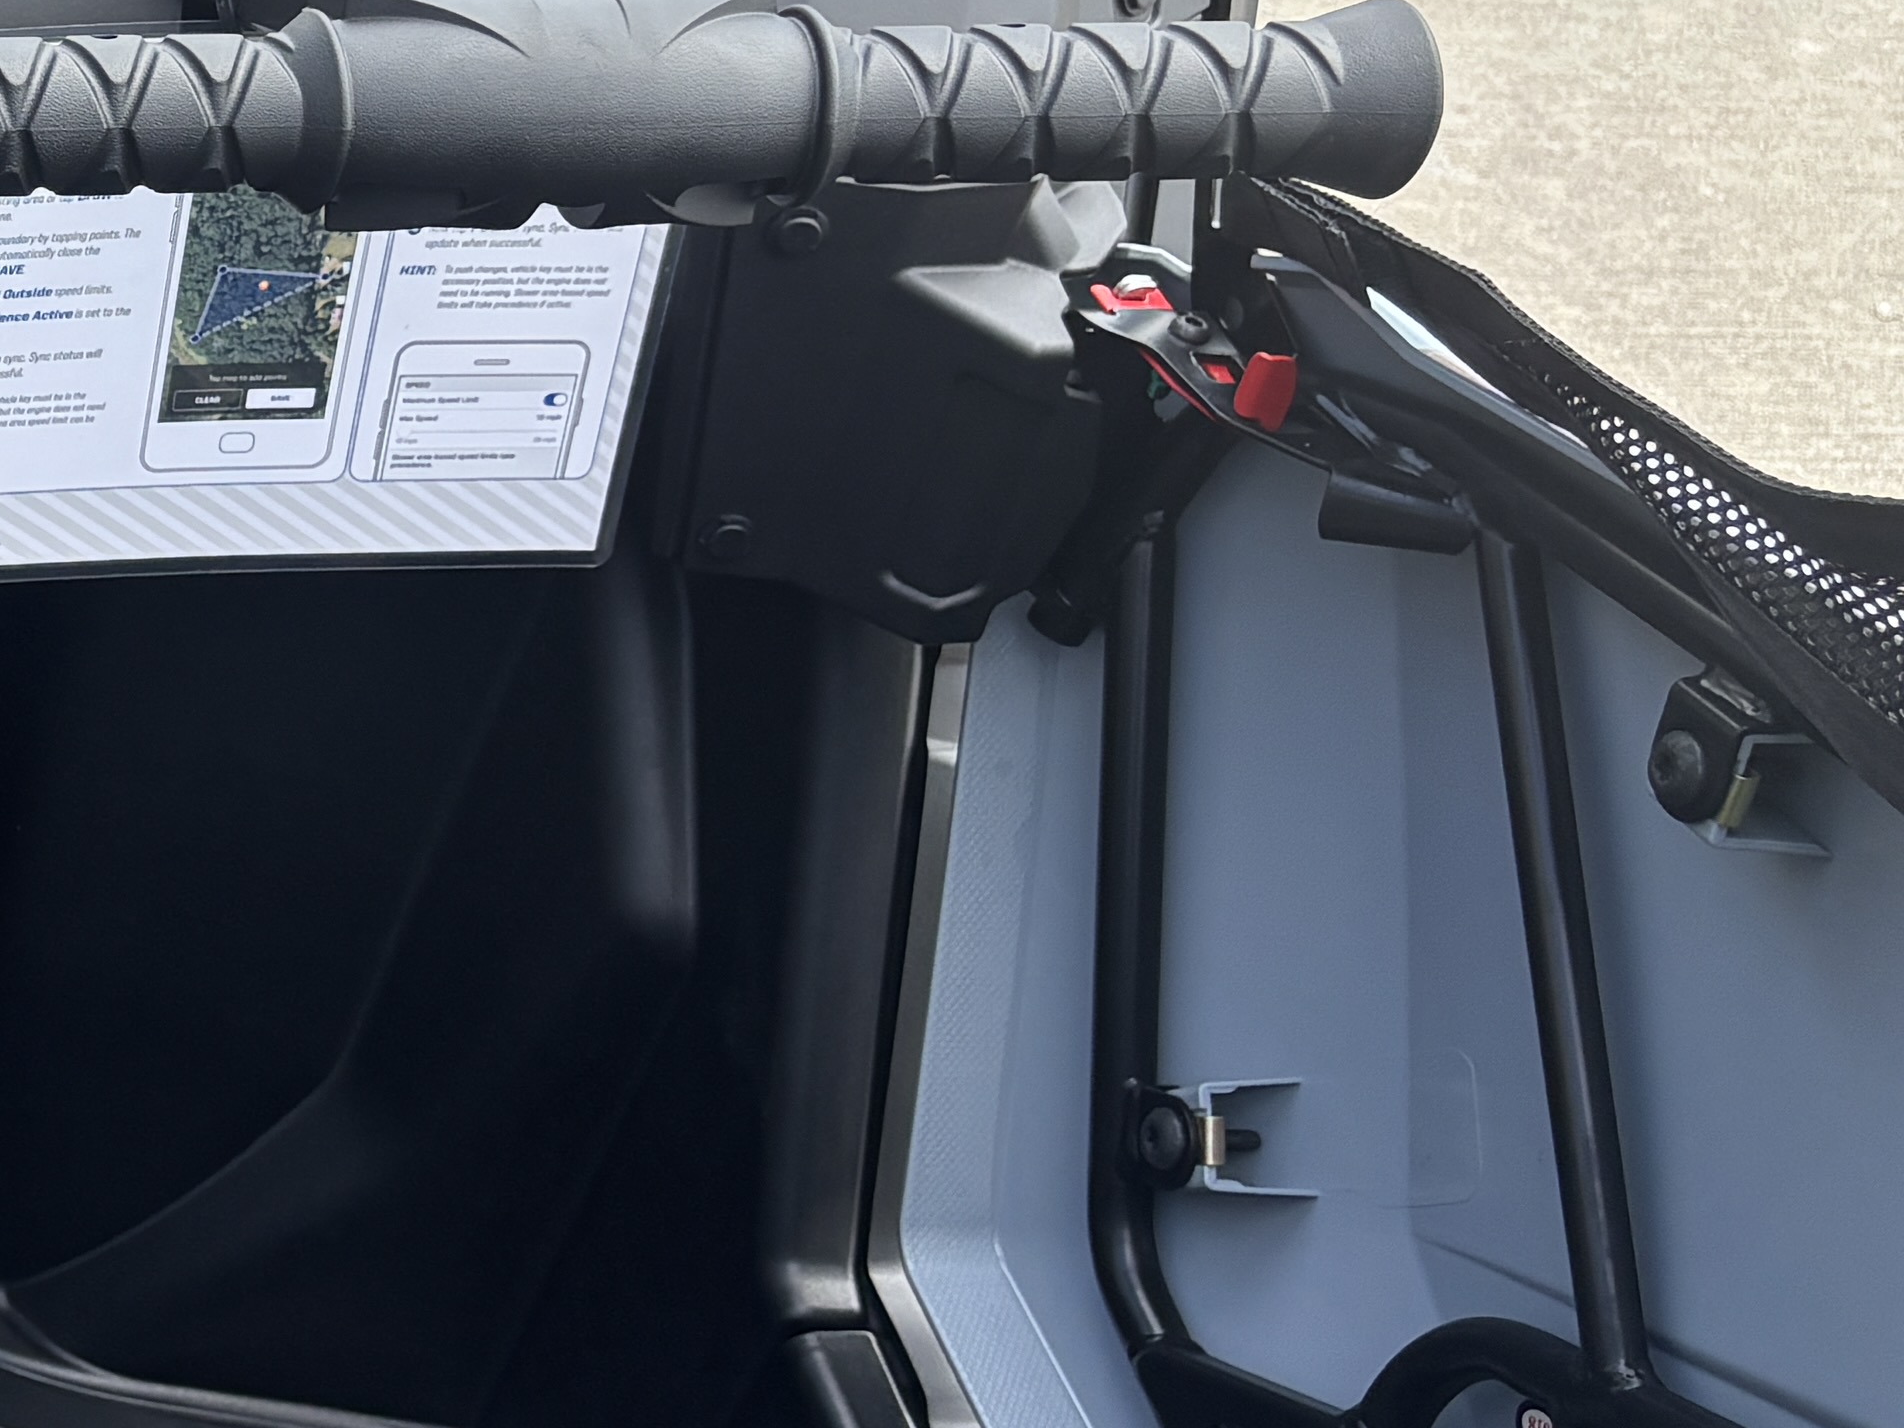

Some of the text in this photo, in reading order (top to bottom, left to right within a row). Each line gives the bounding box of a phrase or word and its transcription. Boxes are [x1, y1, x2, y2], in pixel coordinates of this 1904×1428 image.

[124, 228, 142, 238] The
[84, 245, 101, 256] the
[3, 286, 53, 299] Outside
[32, 309, 73, 321] Active
